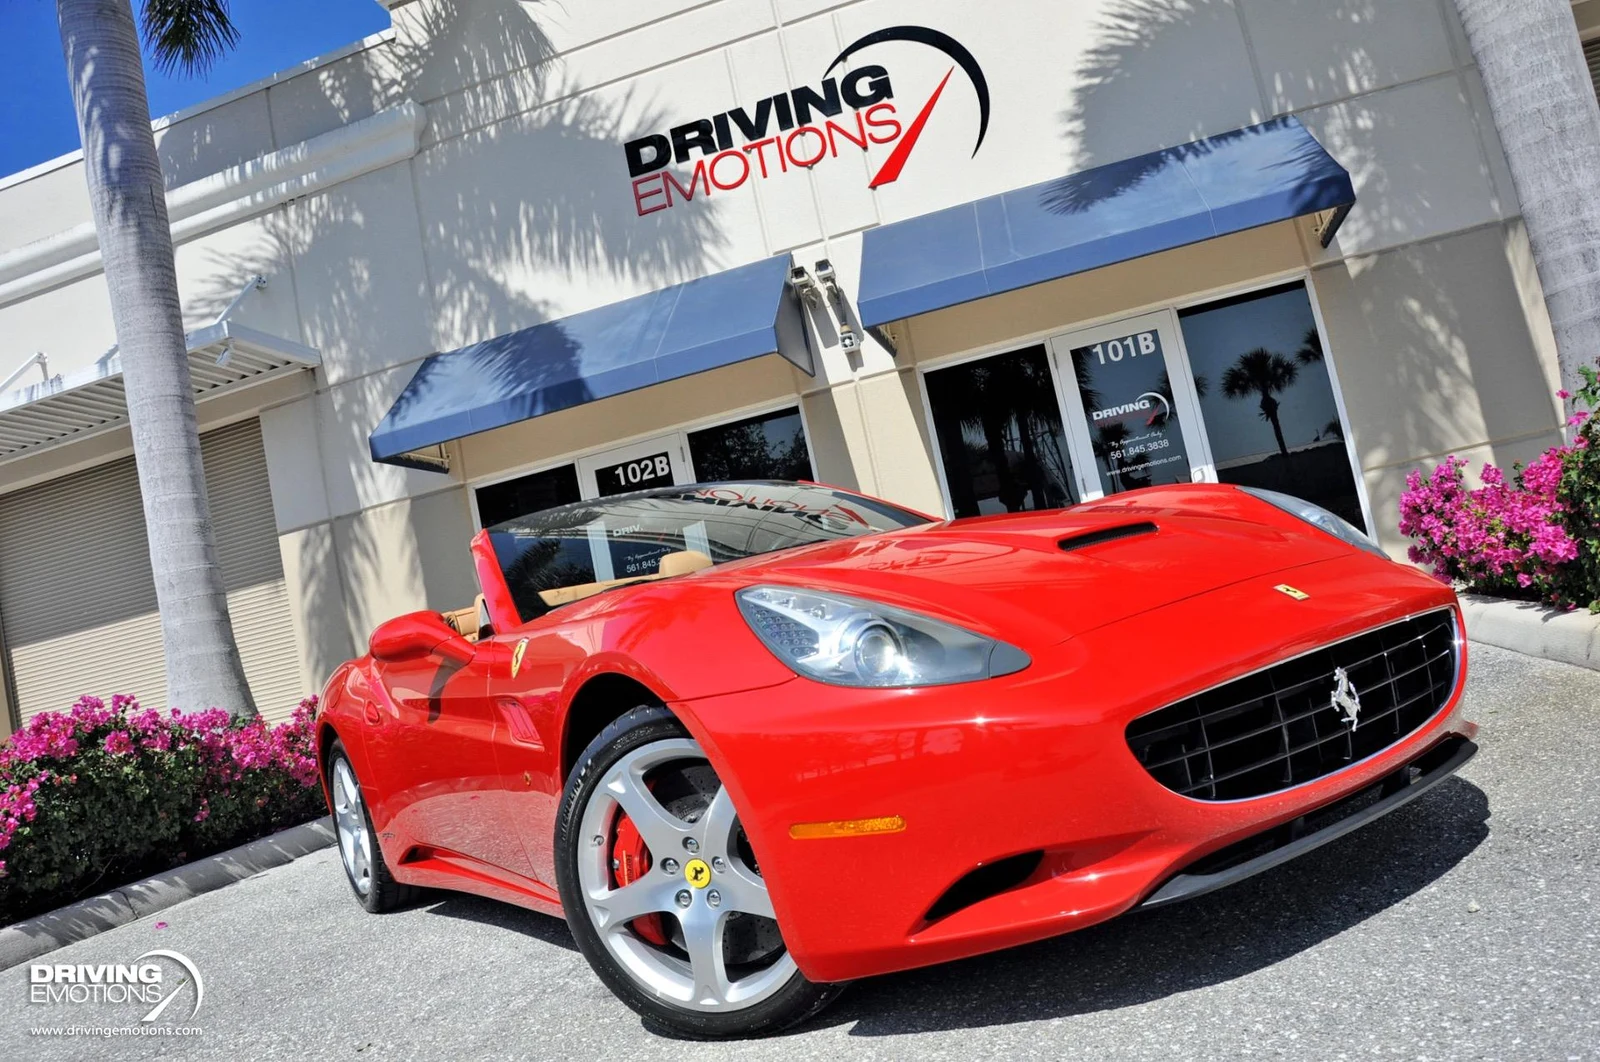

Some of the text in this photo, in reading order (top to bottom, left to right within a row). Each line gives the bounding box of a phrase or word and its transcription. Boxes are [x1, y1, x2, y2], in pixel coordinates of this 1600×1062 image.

[624, 64, 894, 178] DRIVING
[631, 103, 902, 217] EMOTIONS
[1092, 332, 1156, 365] 101B
[1092, 399, 1151, 421] DRIVING
[1110, 438, 1169, 460] 561.845.3838
[614, 455, 670, 486] 102B
[1106, 455, 1182, 476] www.drivingemotions.com
